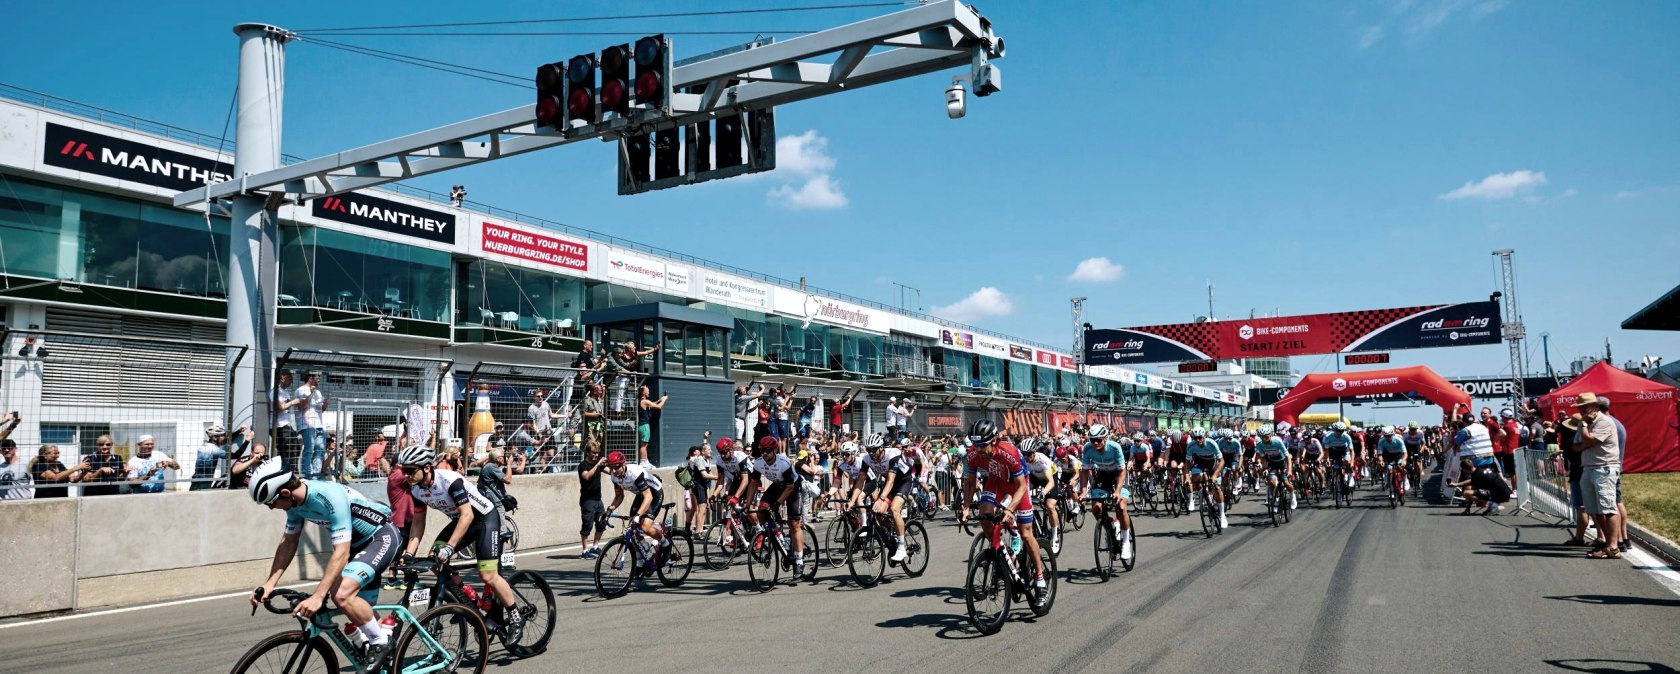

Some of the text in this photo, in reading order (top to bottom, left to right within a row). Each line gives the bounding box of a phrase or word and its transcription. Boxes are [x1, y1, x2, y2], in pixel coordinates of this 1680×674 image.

[350, 201, 447, 234] MANTHEY
[486, 227, 585, 256] YOUR RING. YOUR STYLE.
[484, 240, 586, 268] NUERBURGRING.DE/SHOP
[624, 263, 663, 279] TotalEnergies
[1256, 324, 1309, 336] BIKE-COMPONENTS
[531, 337, 543, 348] 26
[1240, 340, 1307, 352] START / ZIEL
[733, 361, 741, 369] 24
[1348, 377, 1399, 388] BIKE-COMPONENTS
[1635, 390, 1673, 400] abavent
